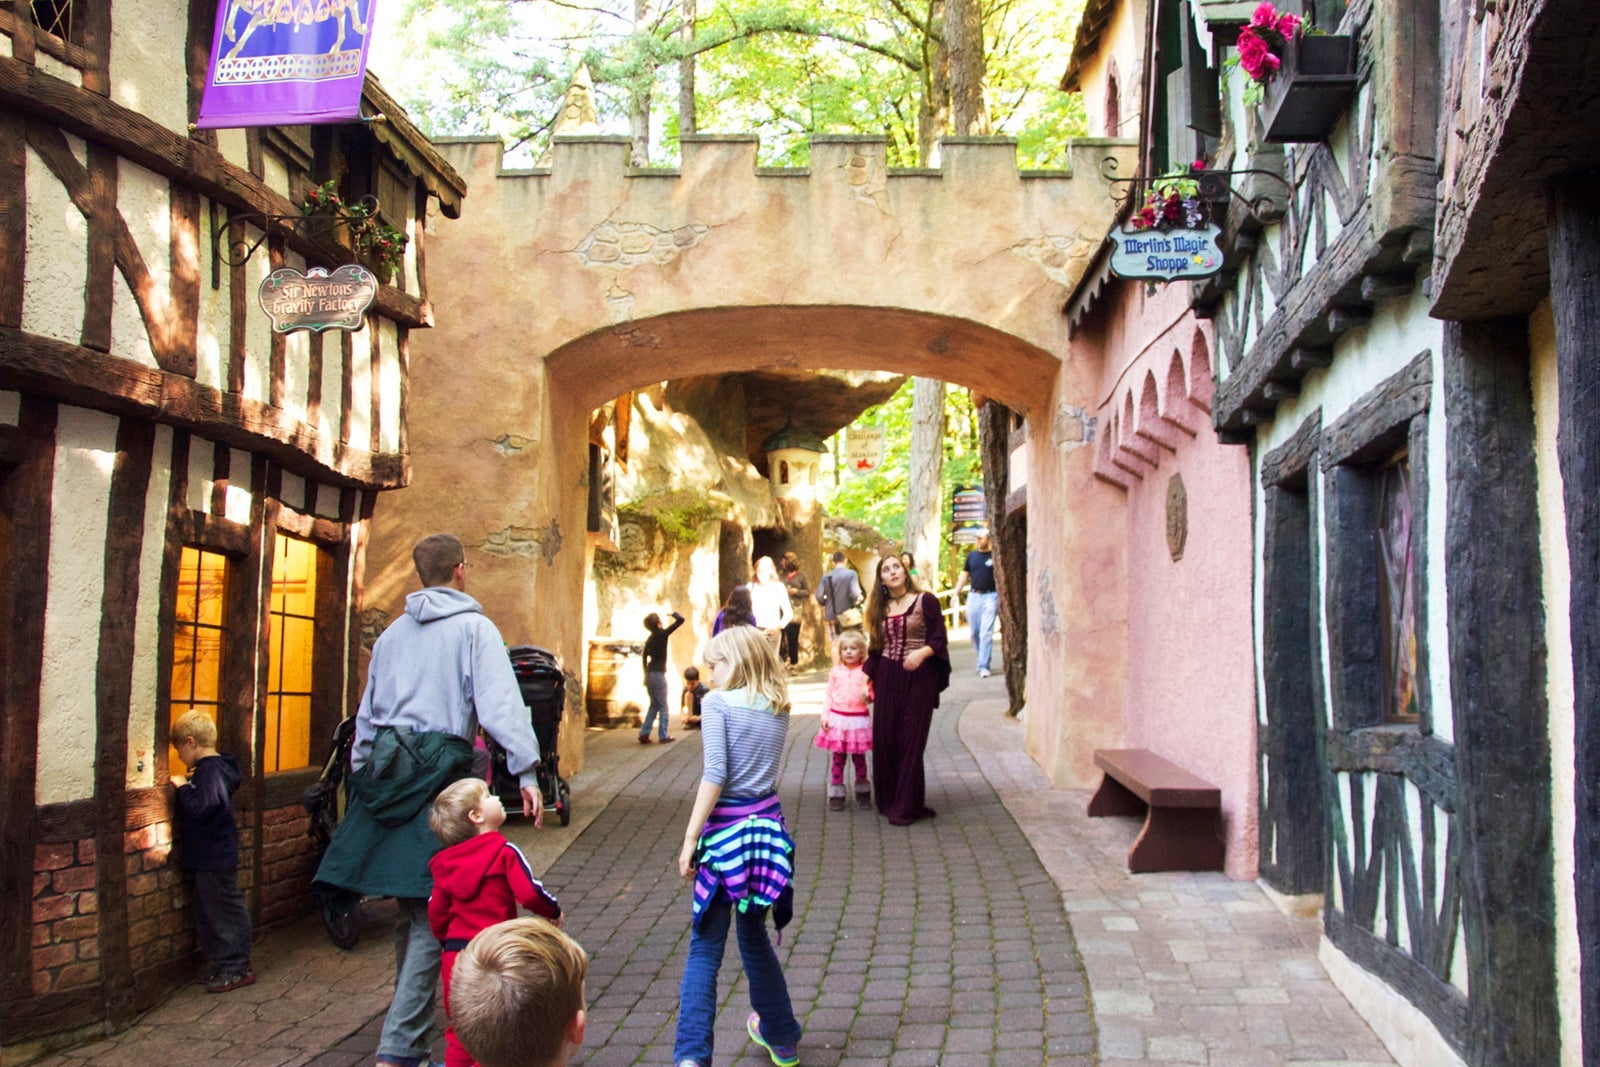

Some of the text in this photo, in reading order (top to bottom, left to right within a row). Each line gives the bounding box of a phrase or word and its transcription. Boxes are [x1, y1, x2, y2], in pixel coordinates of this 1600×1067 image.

[1124, 236, 1209, 256] Merlin's Magic
[1146, 255, 1188, 274] Shoppe
[281, 284, 301, 300] Sir
[272, 297, 362, 316] Gravity Factory
